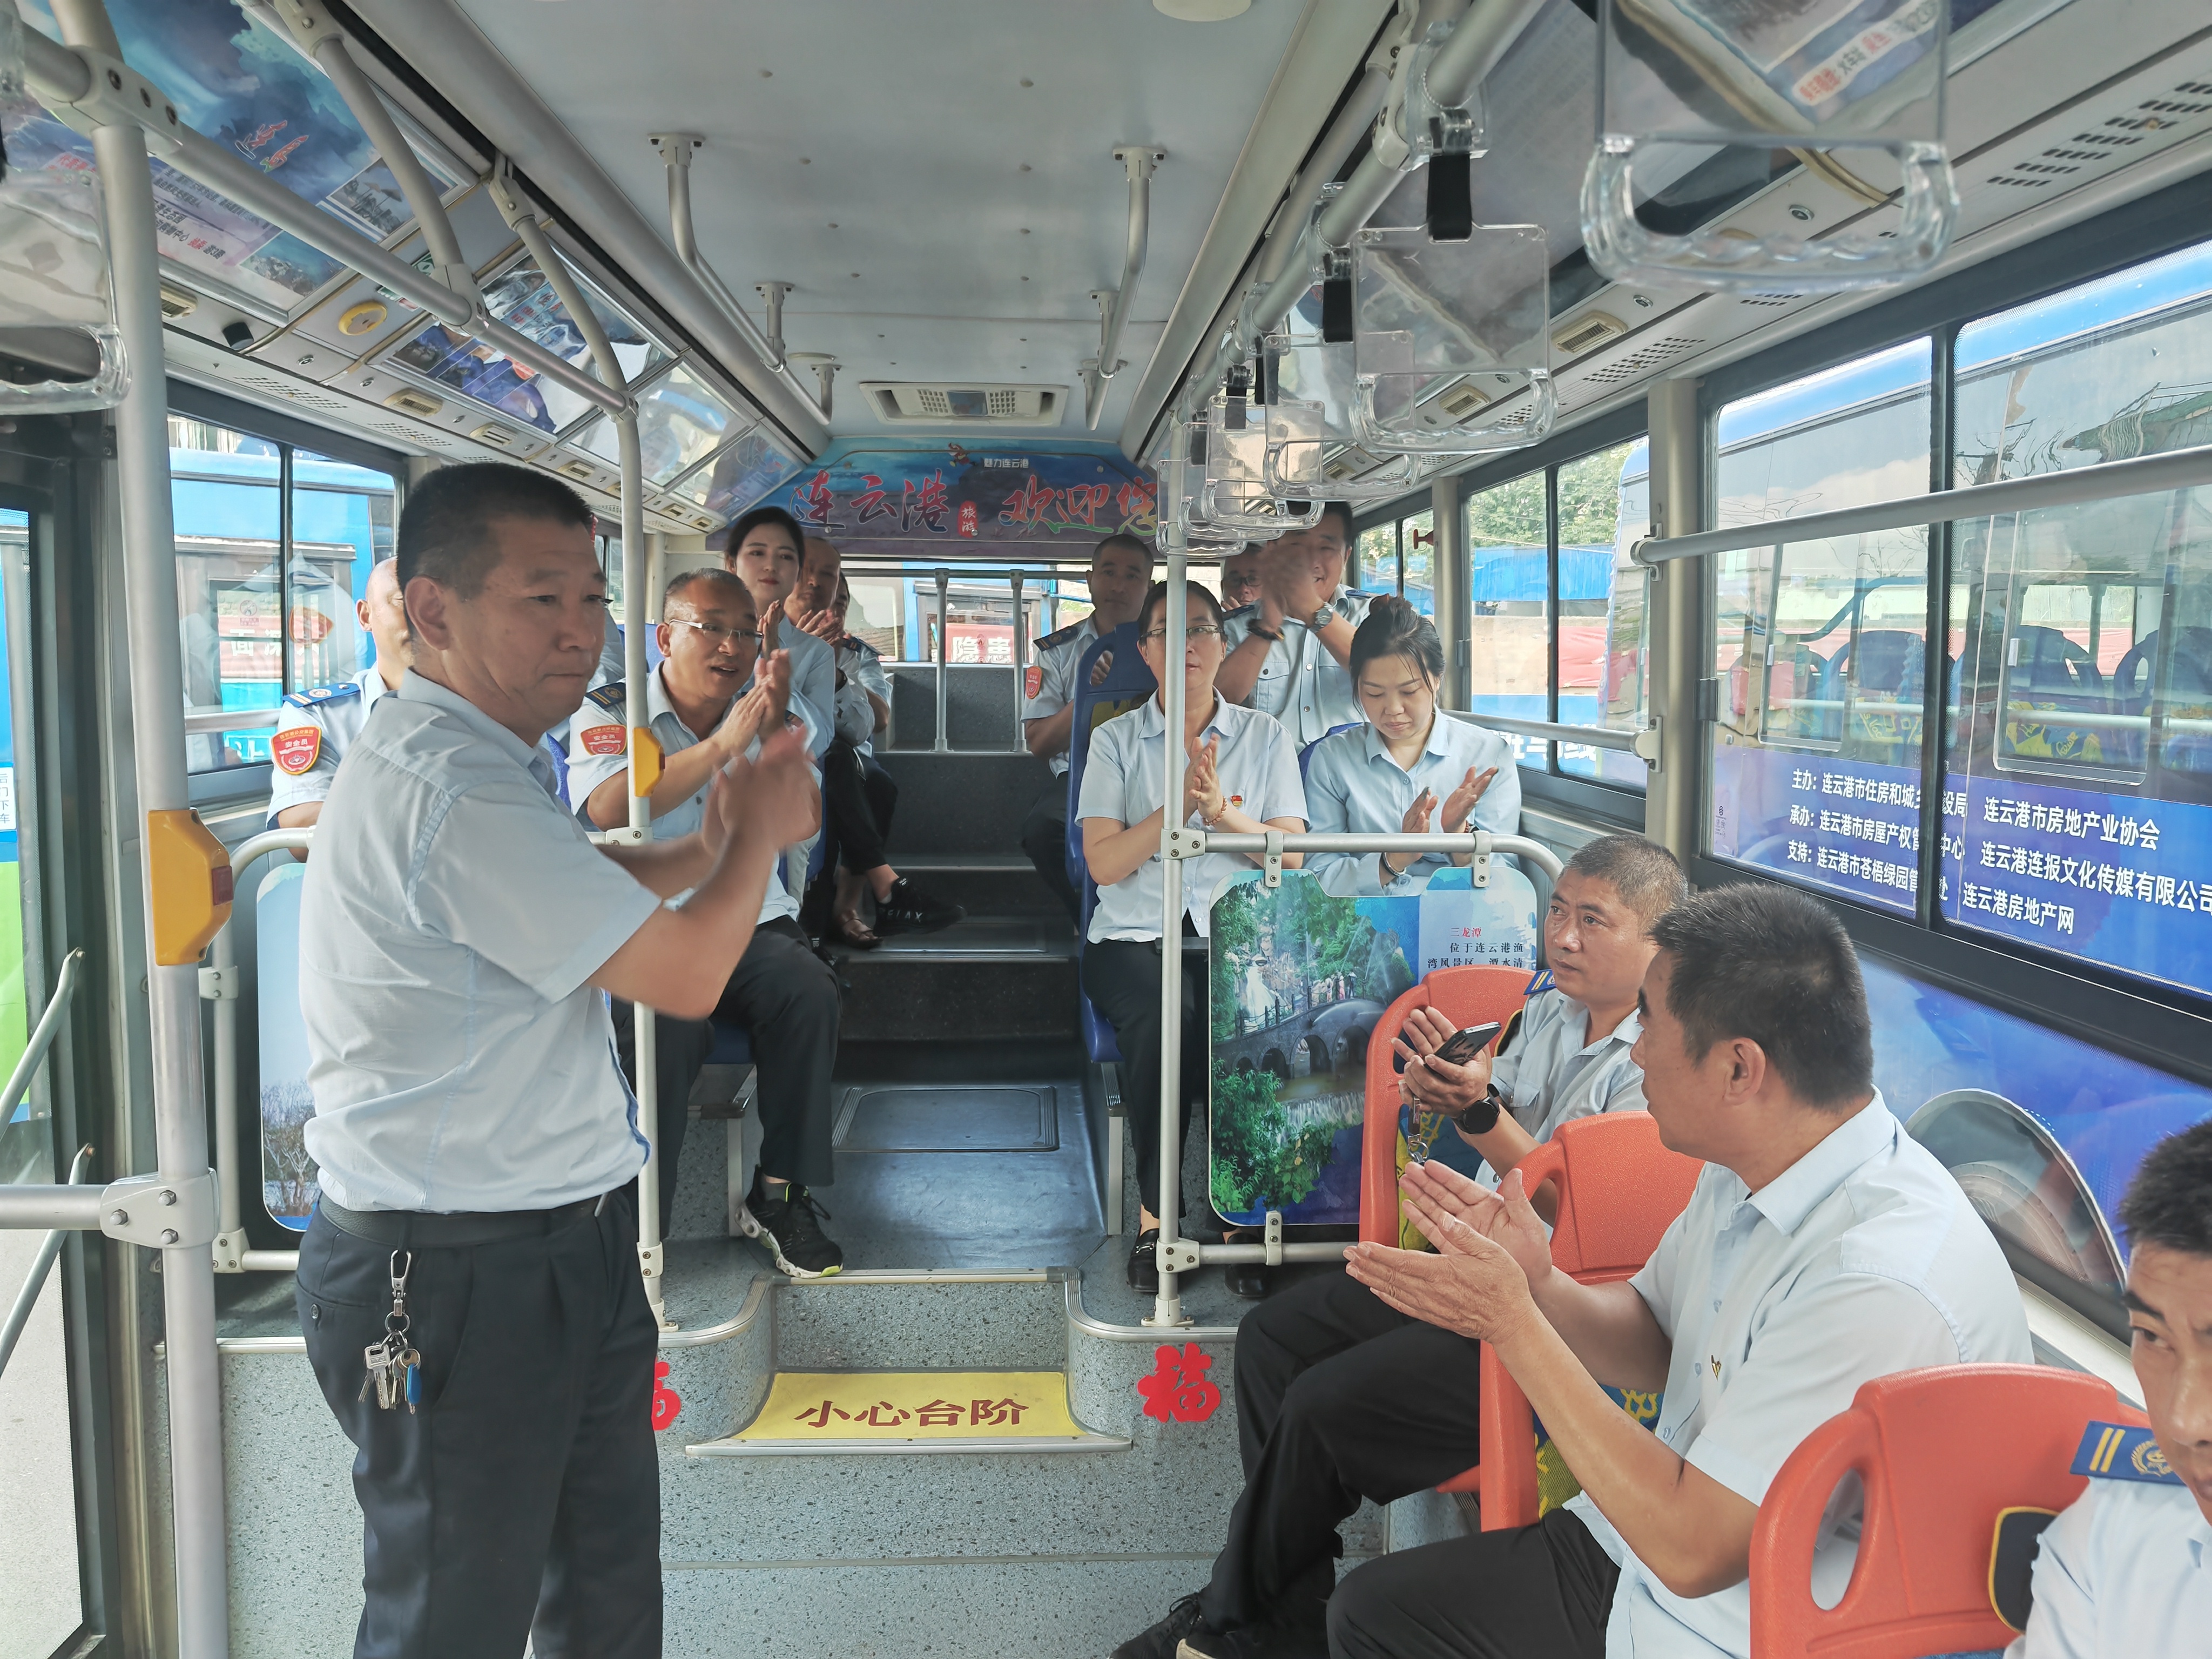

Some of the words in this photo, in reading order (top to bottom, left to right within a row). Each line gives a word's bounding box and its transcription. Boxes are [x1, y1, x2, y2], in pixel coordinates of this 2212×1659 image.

[984, 458, 1029, 468] 魅力连云港
[794, 468, 949, 532] 连云港
[999, 475, 1157, 536] 欢迎您
[952, 637, 1012, 663] 隐患
[285, 738, 308, 748] 安全员
[1983, 796, 2160, 851] 连云港市房地产业协会
[1980, 840, 2212, 916] 连云港连报文化传媒有限公司
[1962, 881, 2075, 934] 连云港房地产网
[1450, 927, 1482, 938] 三龙潭
[1427, 957, 1474, 969] 湾风景区
[1450, 942, 1524, 954] 位于连云港渔
[1137, 1343, 1222, 1423] 福
[794, 1398, 1029, 1428] 小心台阶
